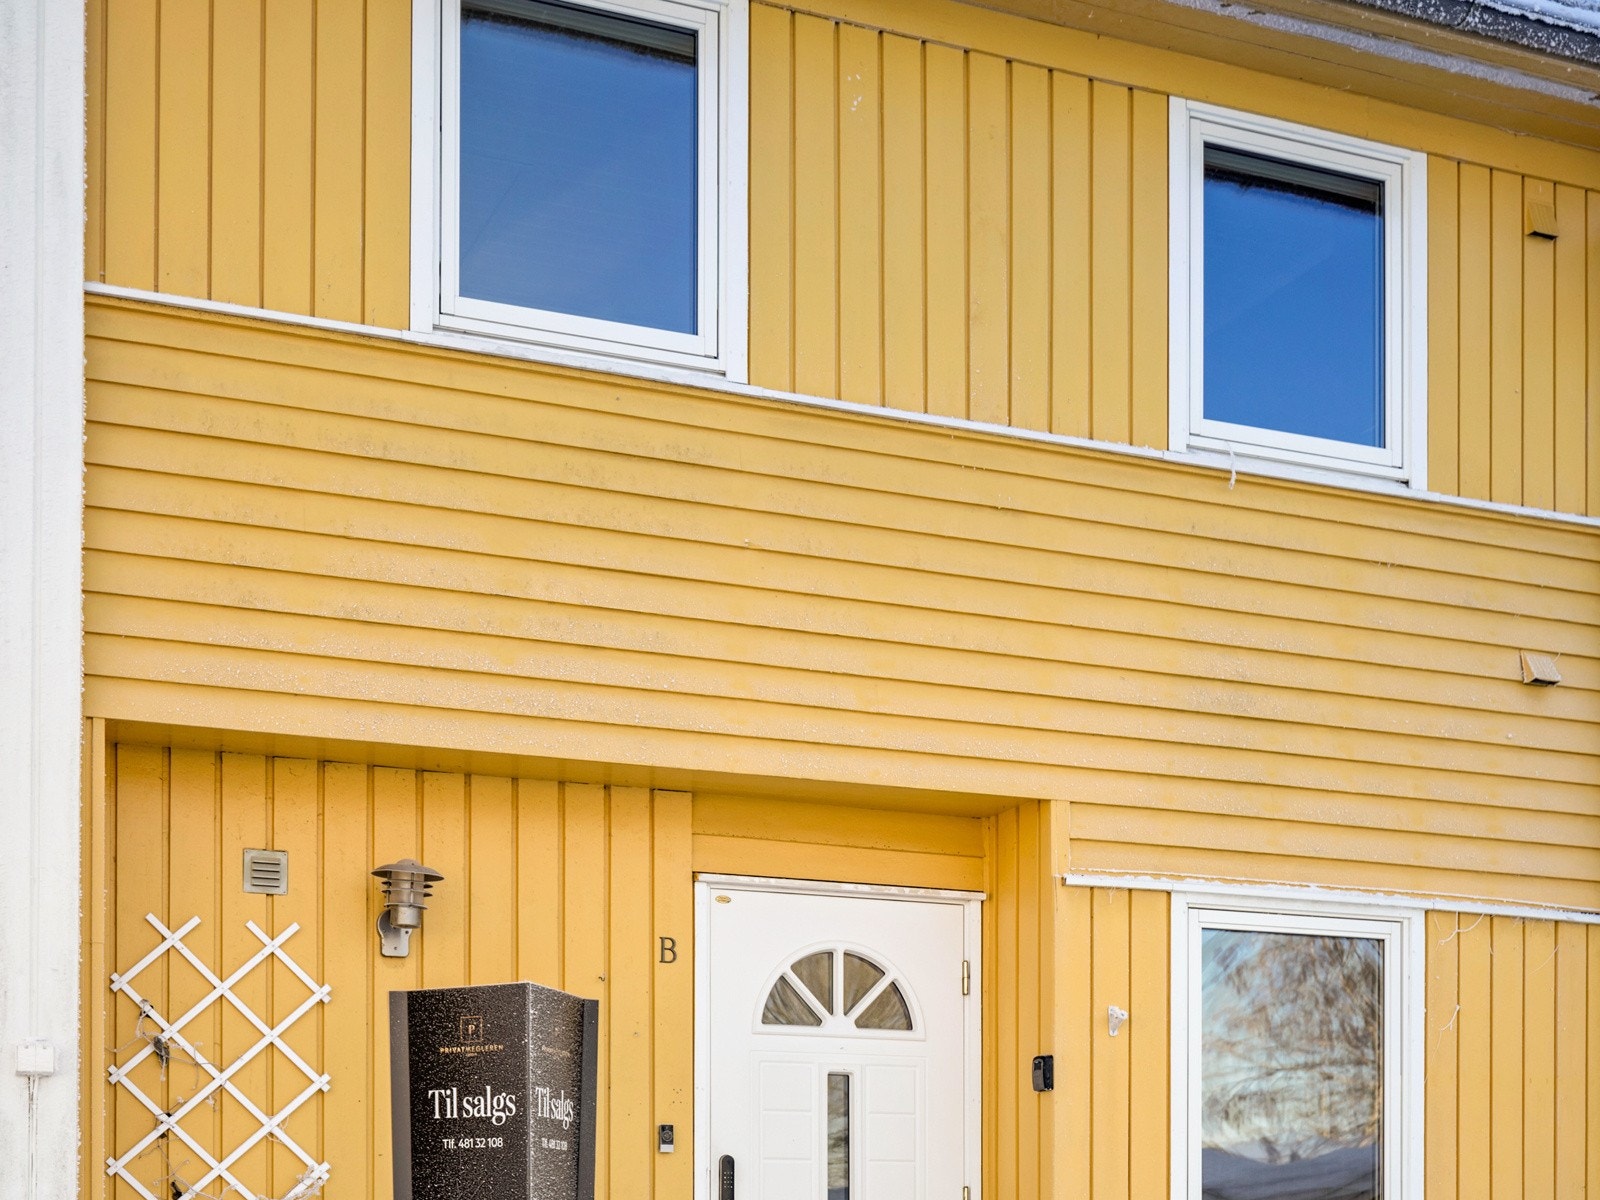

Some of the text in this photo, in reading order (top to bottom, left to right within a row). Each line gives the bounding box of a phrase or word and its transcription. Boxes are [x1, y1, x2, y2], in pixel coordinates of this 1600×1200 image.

[659, 936, 677, 964] B
[428, 1085, 516, 1126] Til salgs
[535, 1087, 574, 1130] Til salgs
[442, 1136, 504, 1149] Tlf. 481 32 108
